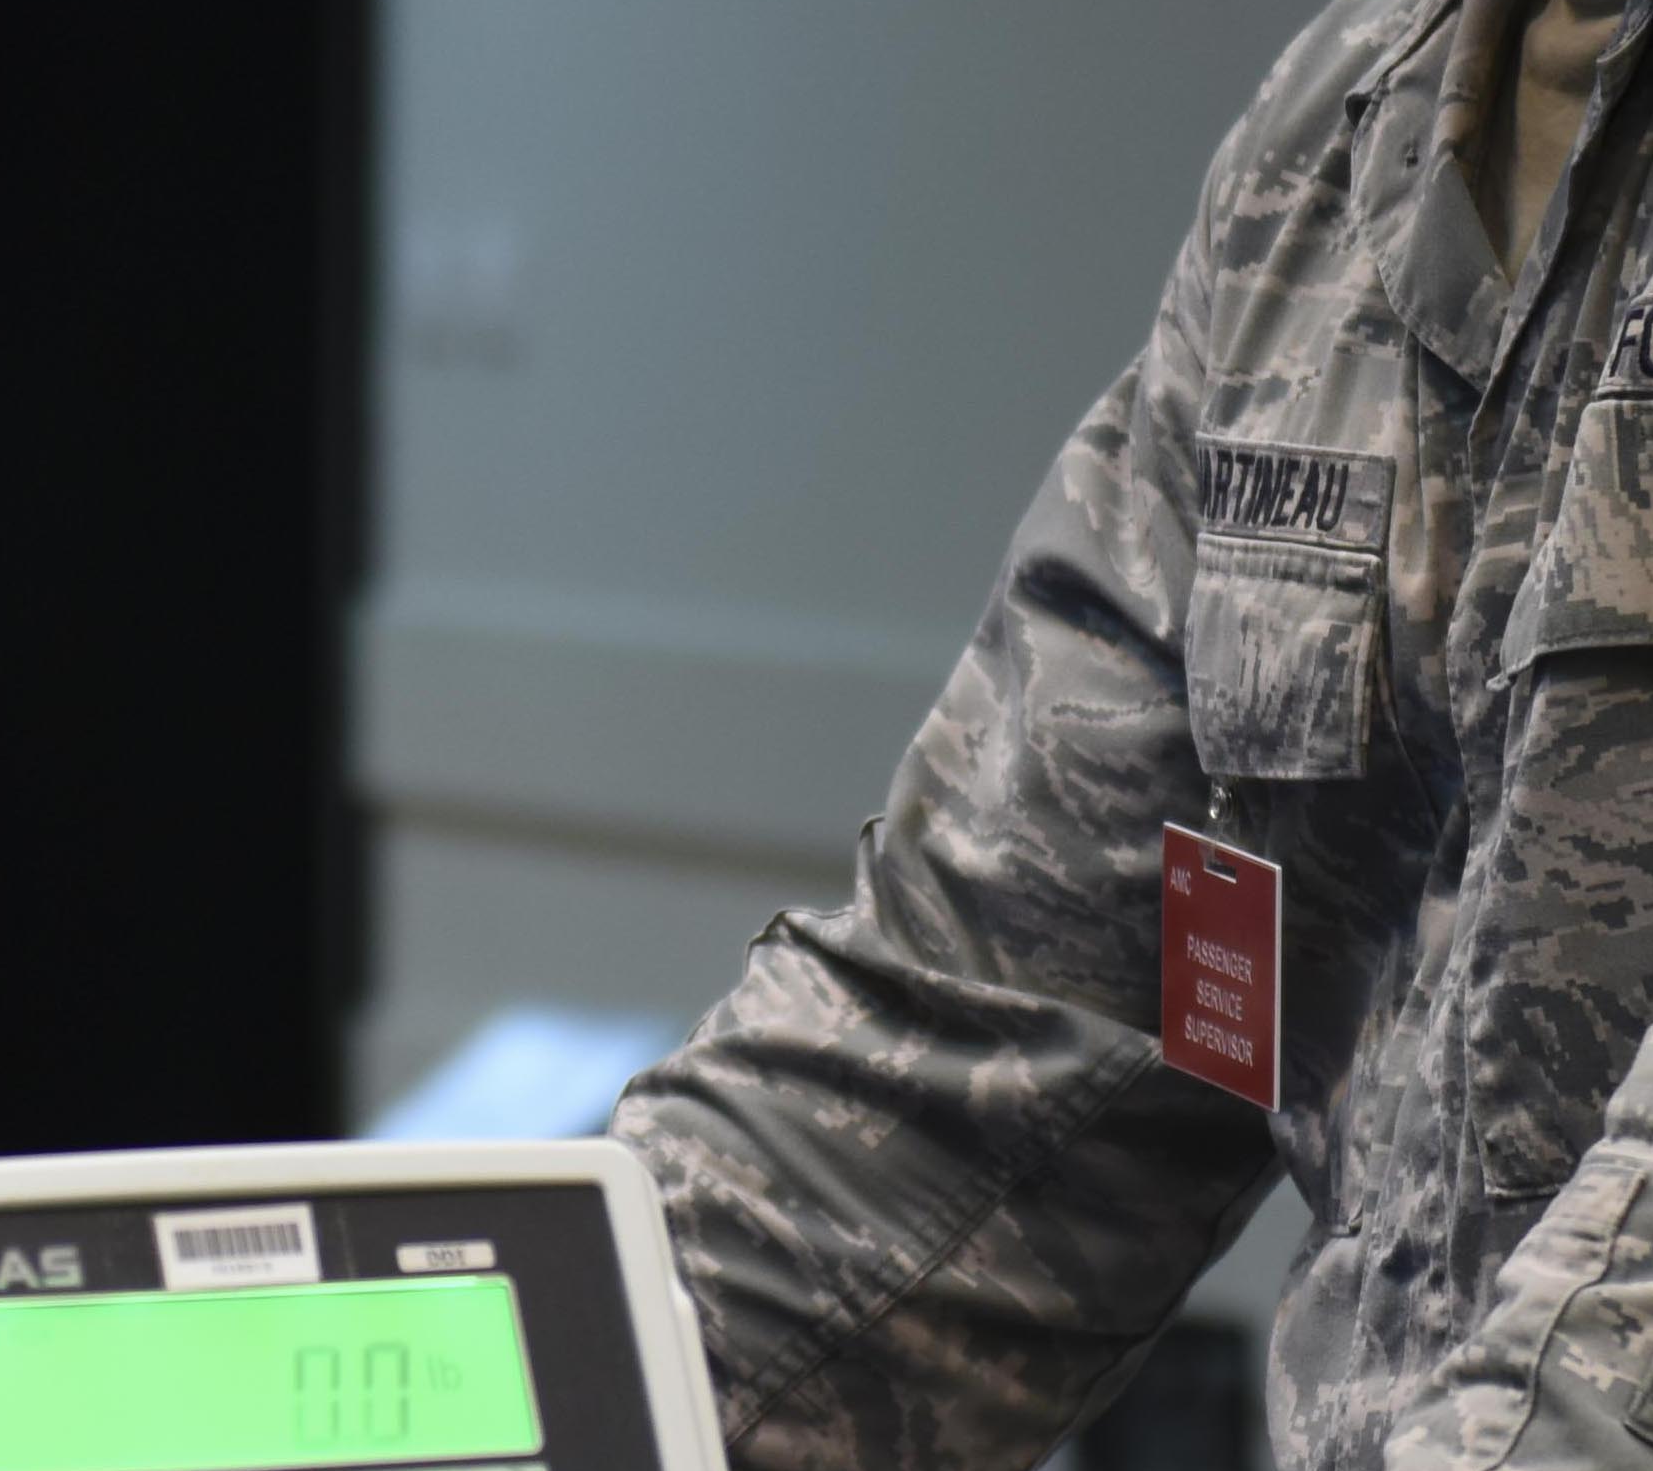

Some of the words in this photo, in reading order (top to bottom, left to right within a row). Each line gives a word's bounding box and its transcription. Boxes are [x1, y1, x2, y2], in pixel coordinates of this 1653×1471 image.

[1198, 448, 1349, 532] ARTINEAU
[1170, 866, 1192, 896] AMC
[1187, 934, 1253, 985] PASSENGER
[1196, 980, 1243, 1021] SERVICE
[1185, 1014, 1253, 1067] SUPERVISOR
